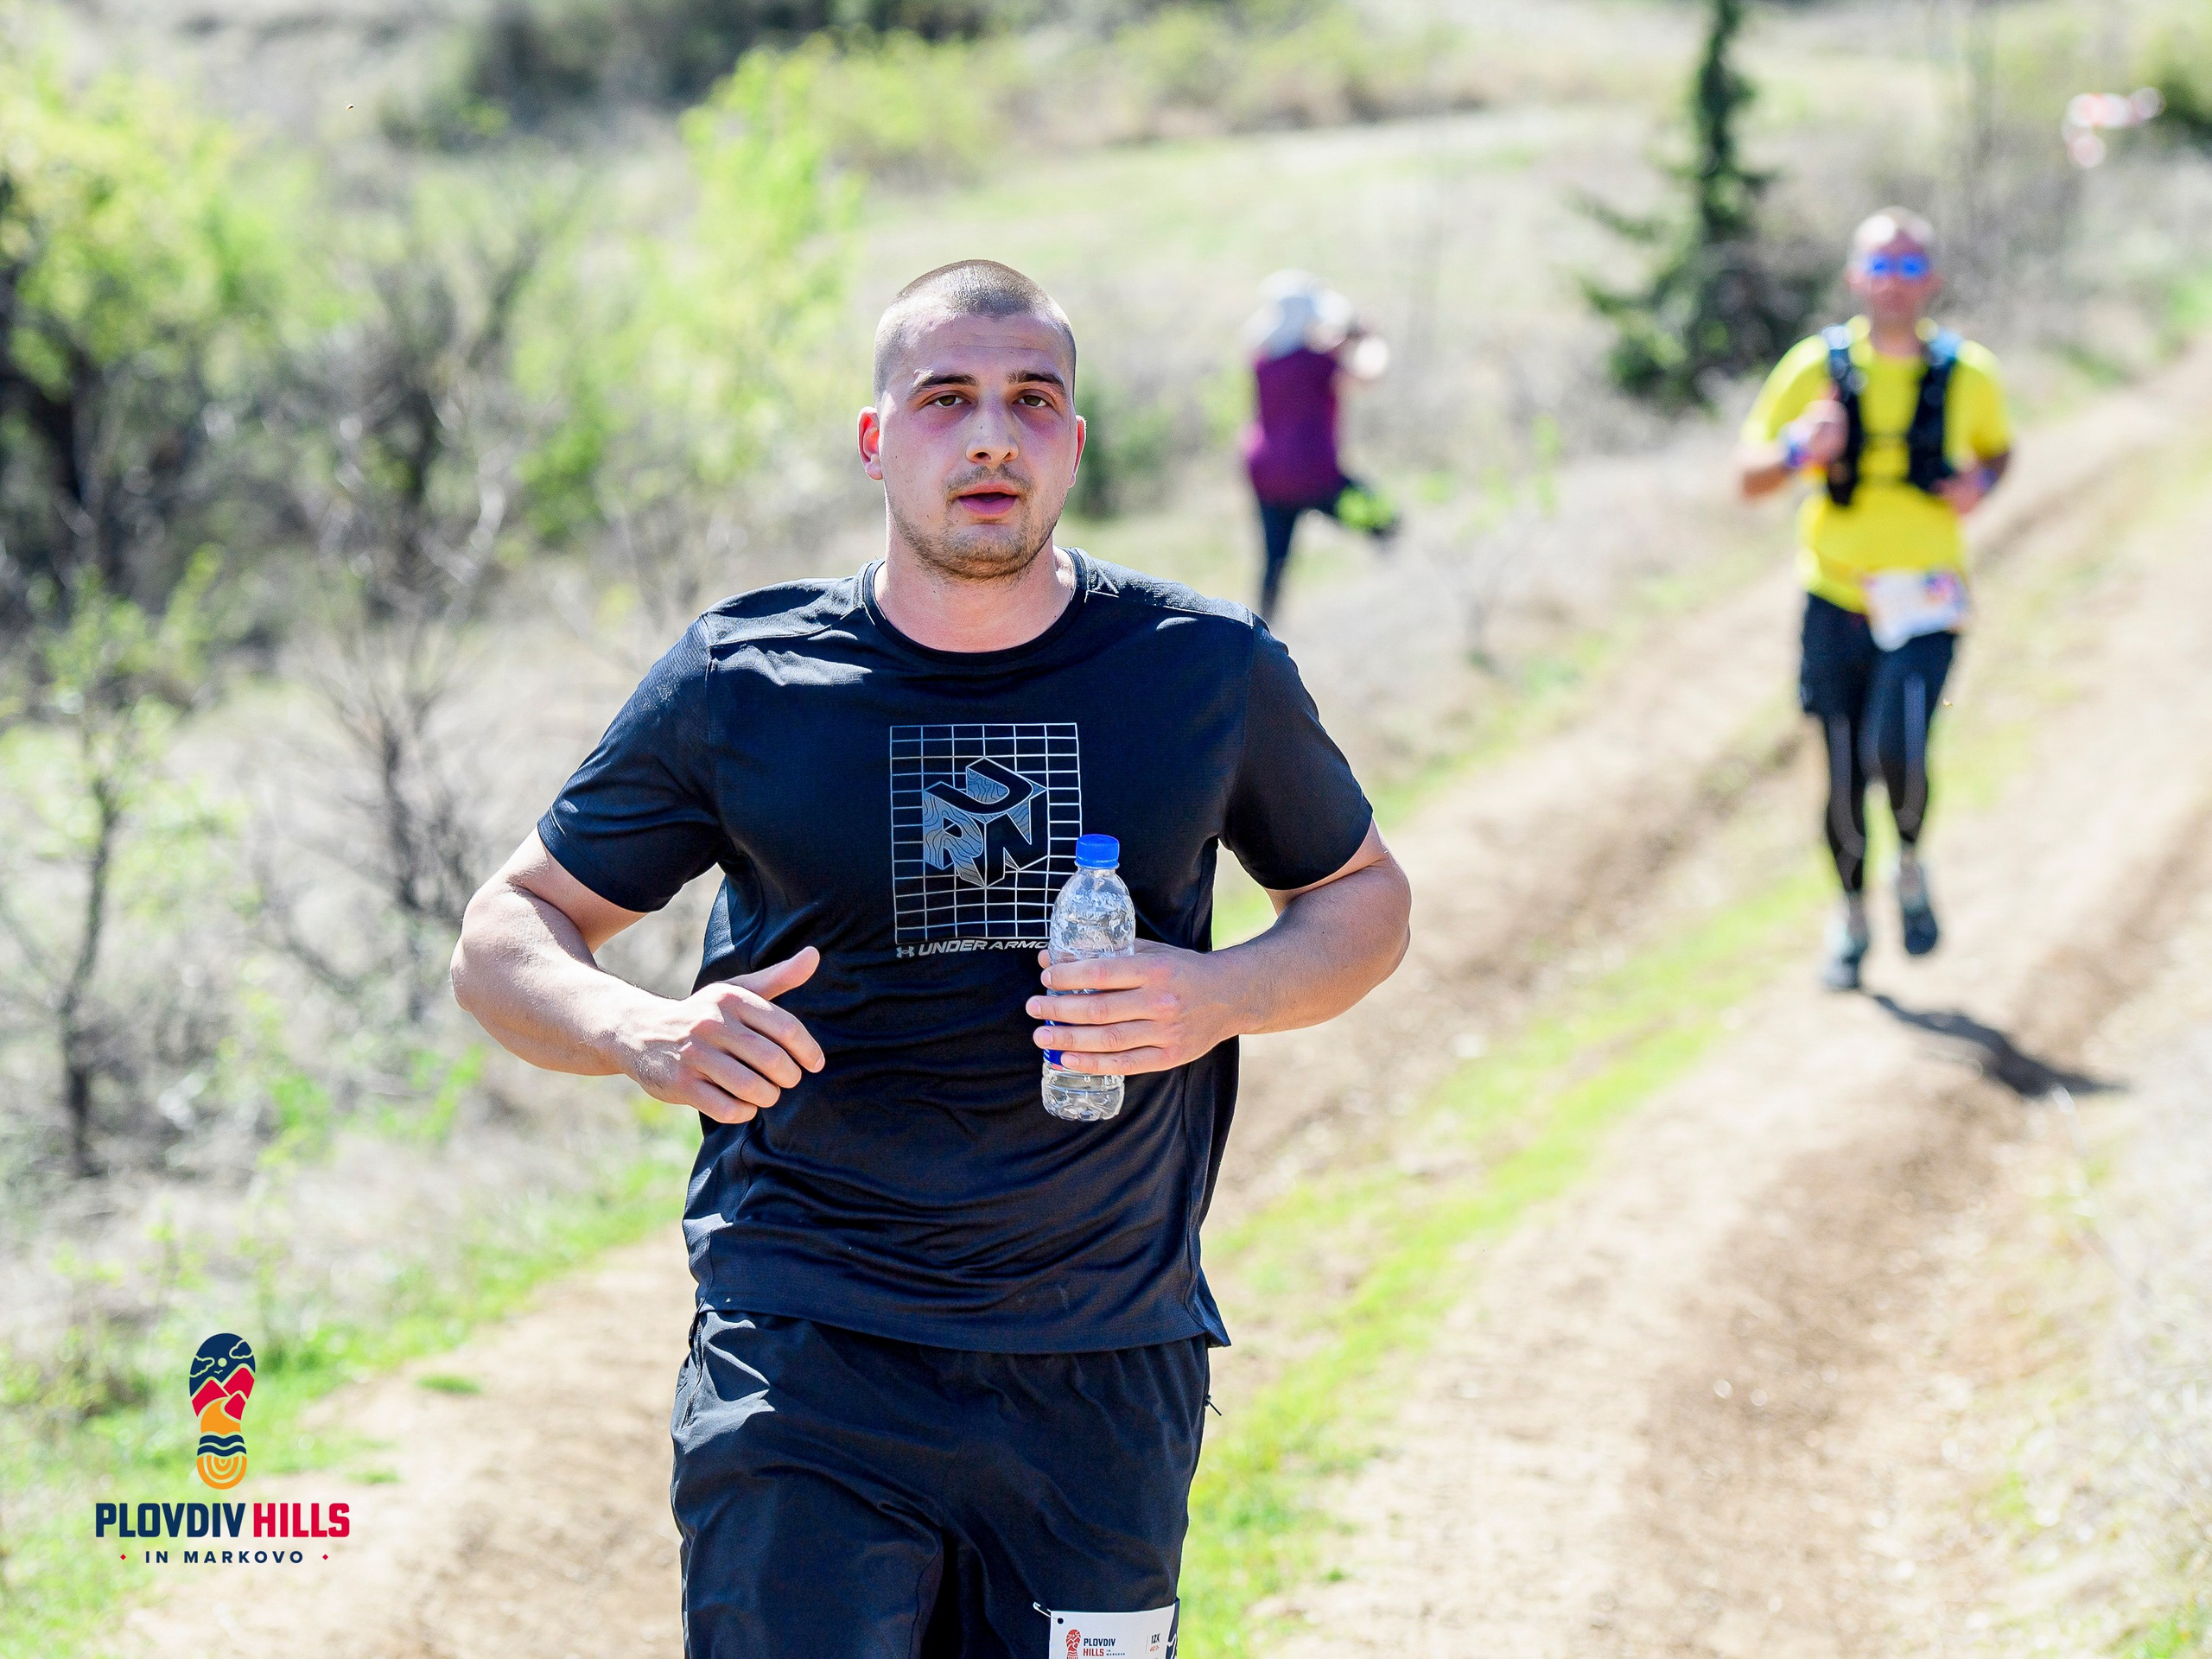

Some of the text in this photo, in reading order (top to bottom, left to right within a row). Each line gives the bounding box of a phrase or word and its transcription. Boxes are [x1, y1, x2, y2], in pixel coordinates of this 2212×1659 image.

[918, 939, 1049, 956] UNDER ARMO
[1083, 1648, 1104, 1656] HILLS
